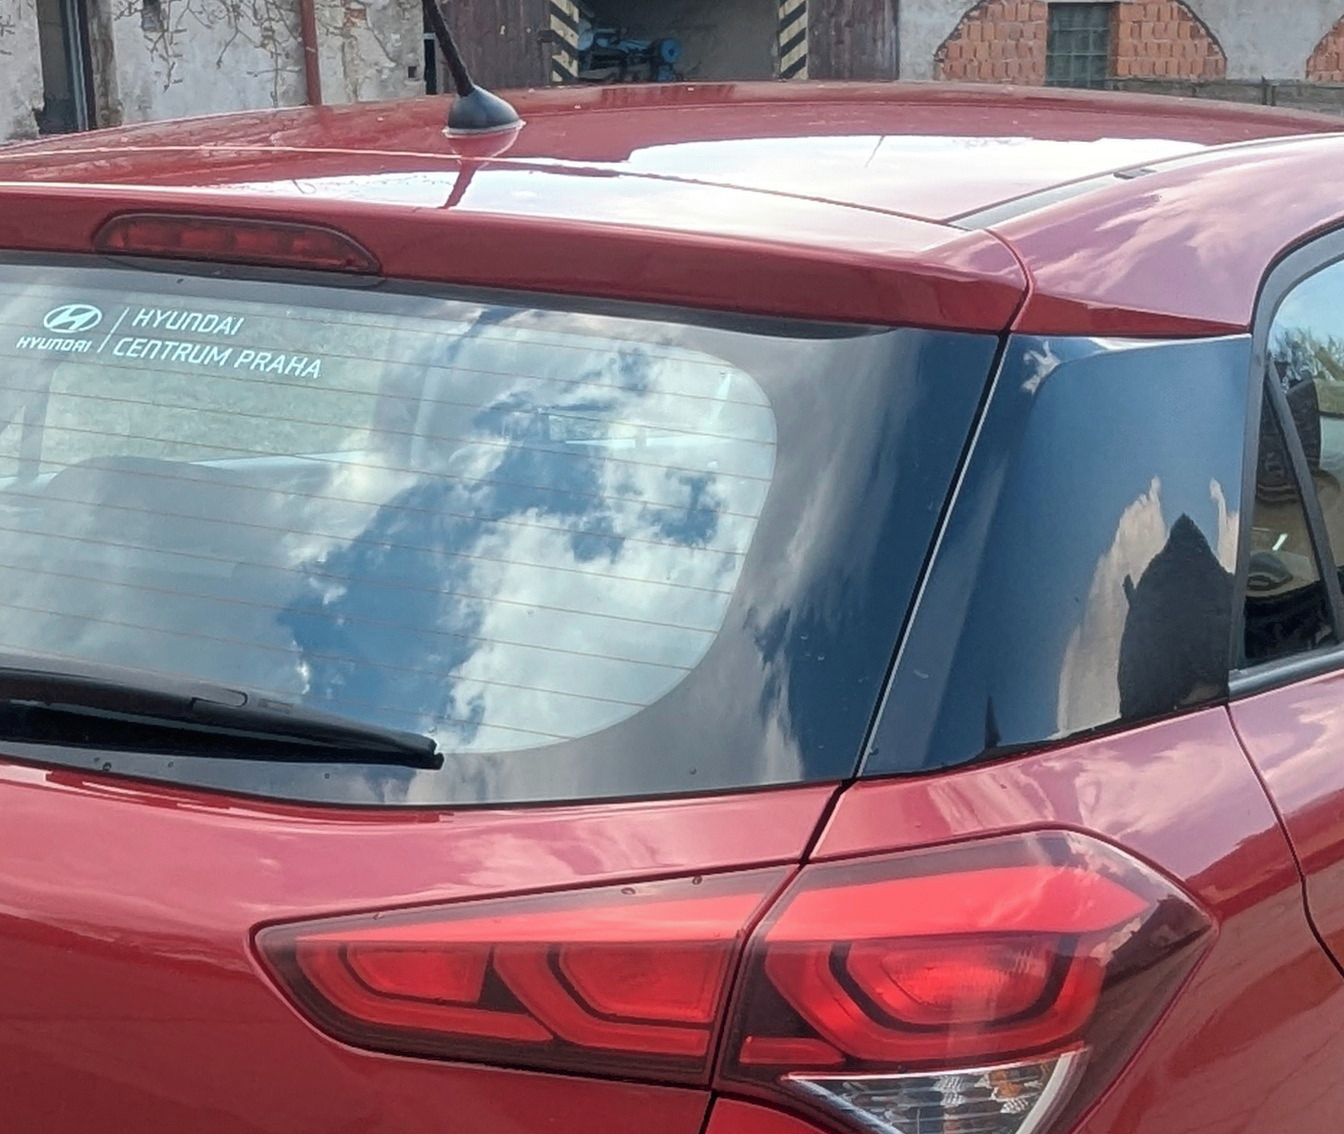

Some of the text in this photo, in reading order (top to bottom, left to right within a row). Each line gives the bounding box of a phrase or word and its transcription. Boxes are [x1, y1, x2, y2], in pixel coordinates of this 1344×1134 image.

[131, 307, 245, 336] HYUNDAI
[16, 336, 92, 353] HYUNDAI
[112, 336, 322, 379] CENTRUM PRAHA
